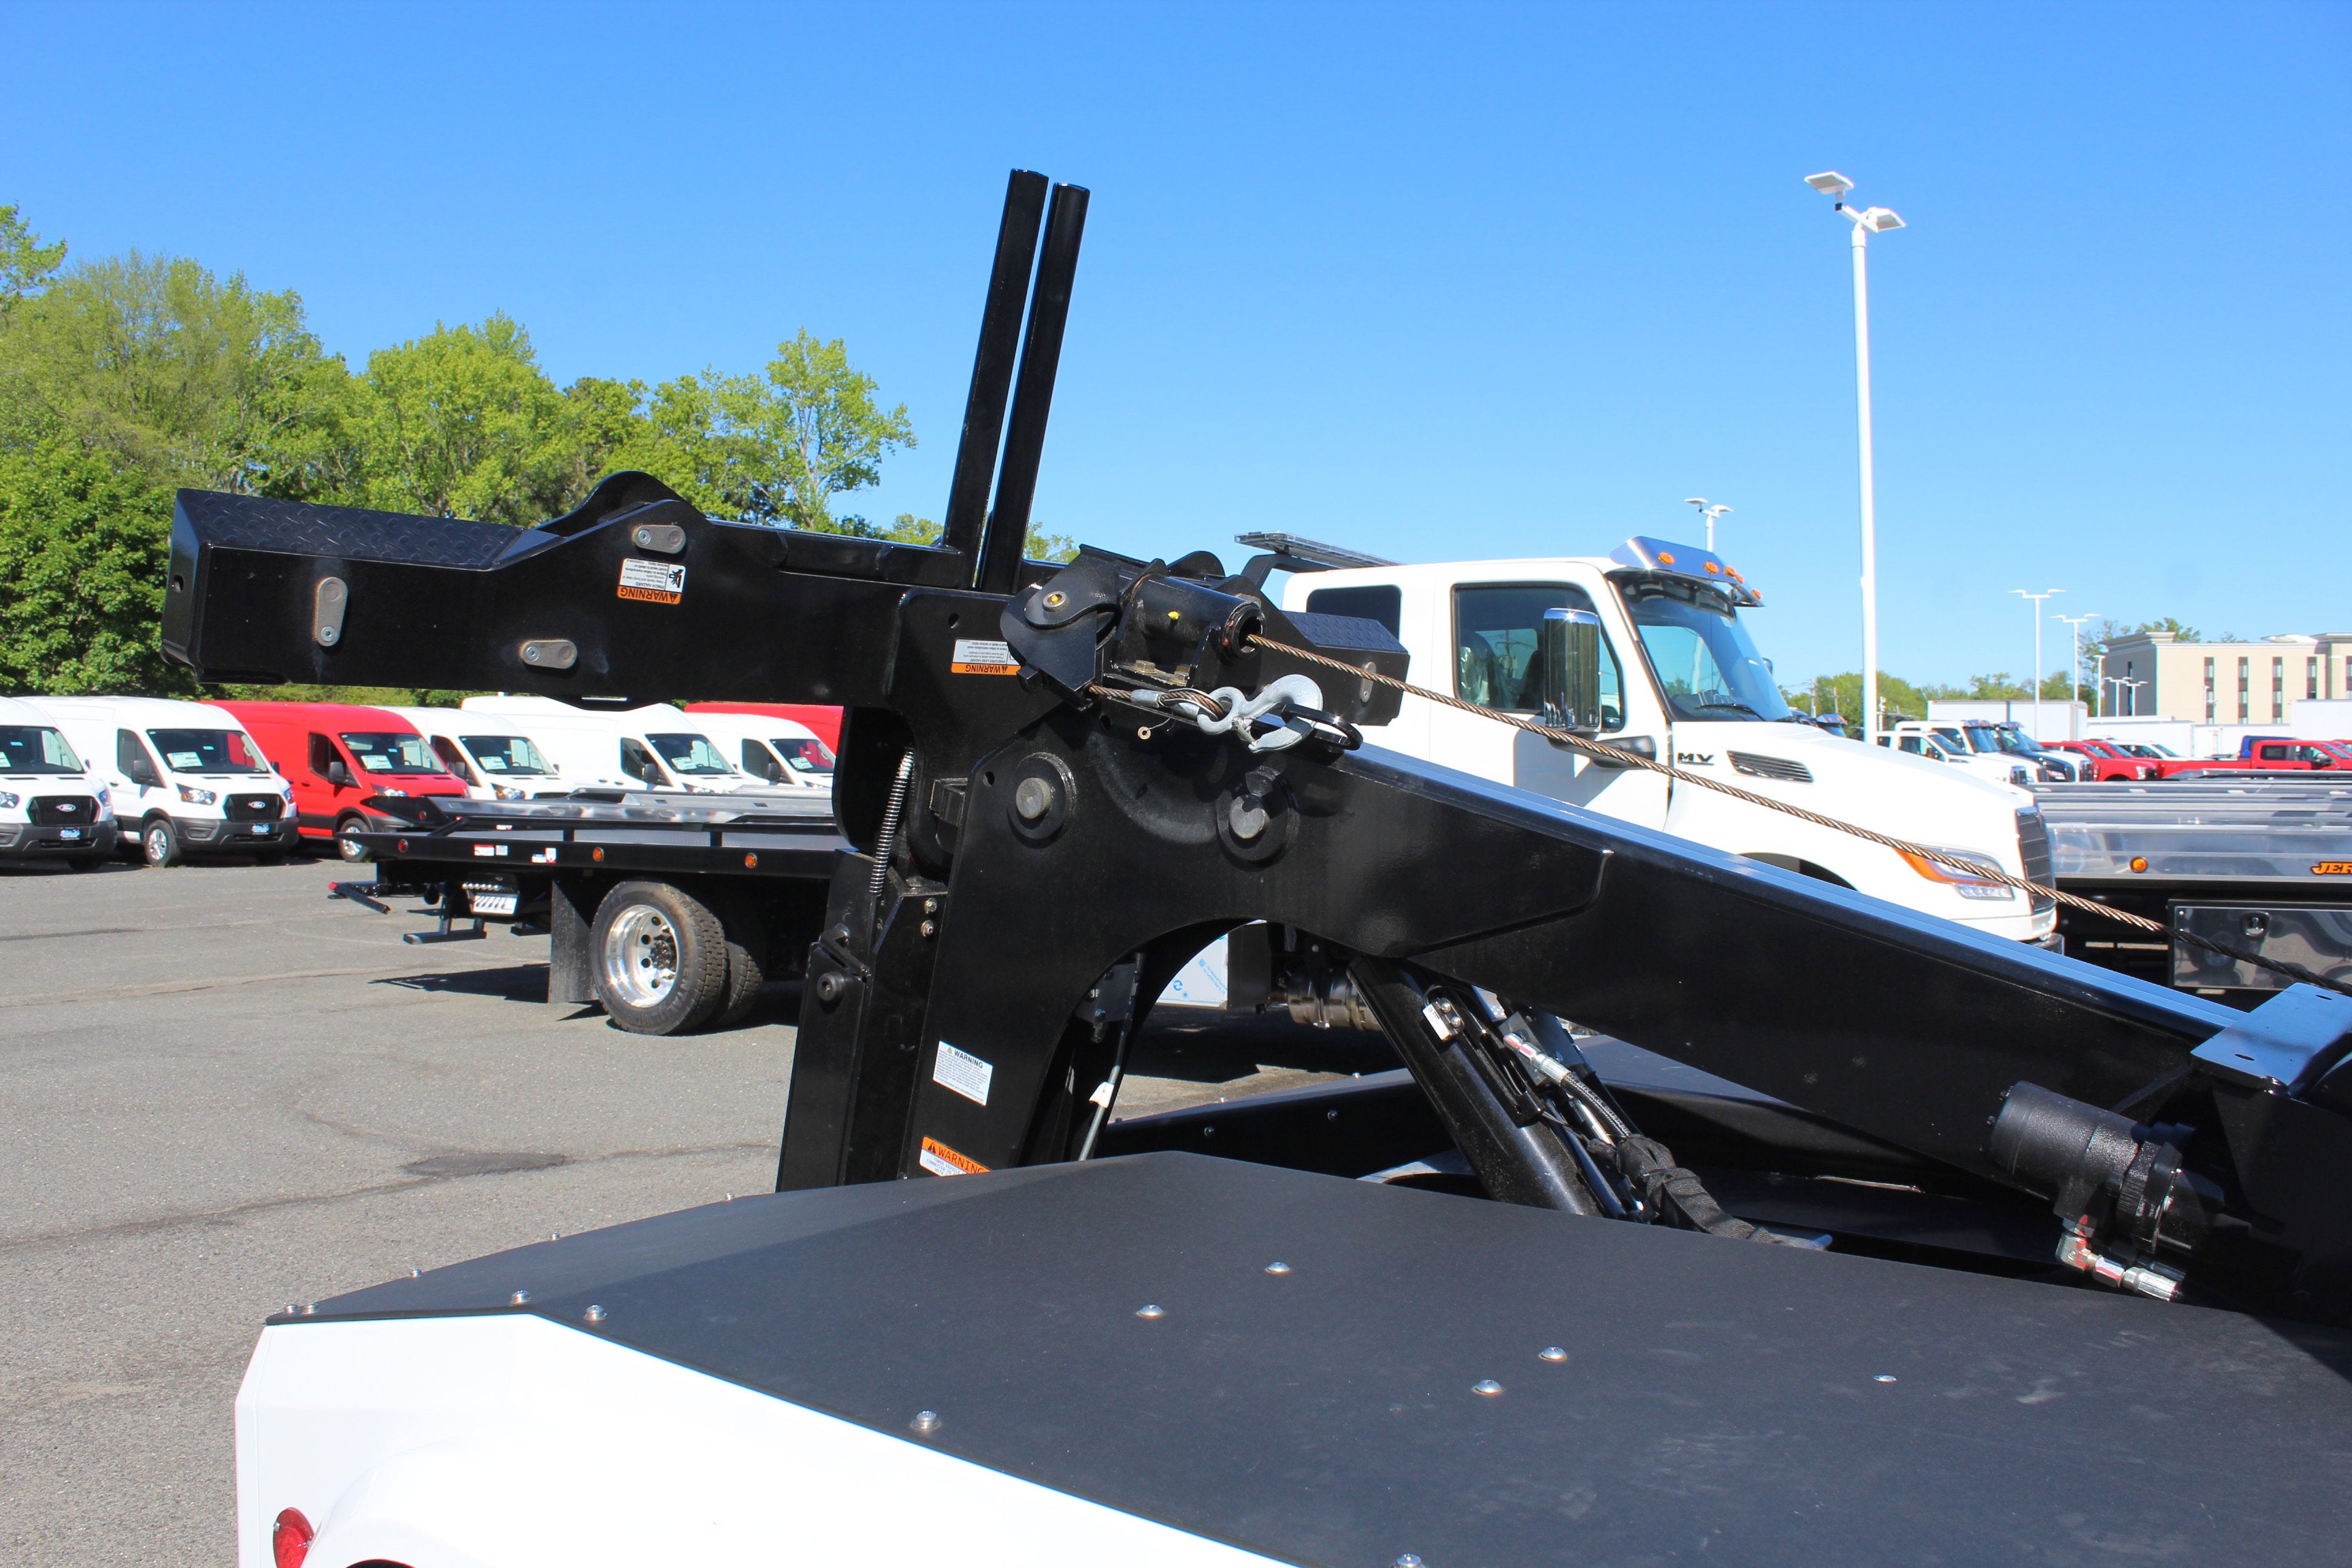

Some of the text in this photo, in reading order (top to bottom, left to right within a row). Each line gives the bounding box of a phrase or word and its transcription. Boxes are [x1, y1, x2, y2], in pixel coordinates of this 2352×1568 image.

[621, 587, 668, 602] WARNING
[966, 664, 1000, 672] WARNING
[1678, 752, 1714, 762] MV
[954, 1049, 983, 1068] WARNING
